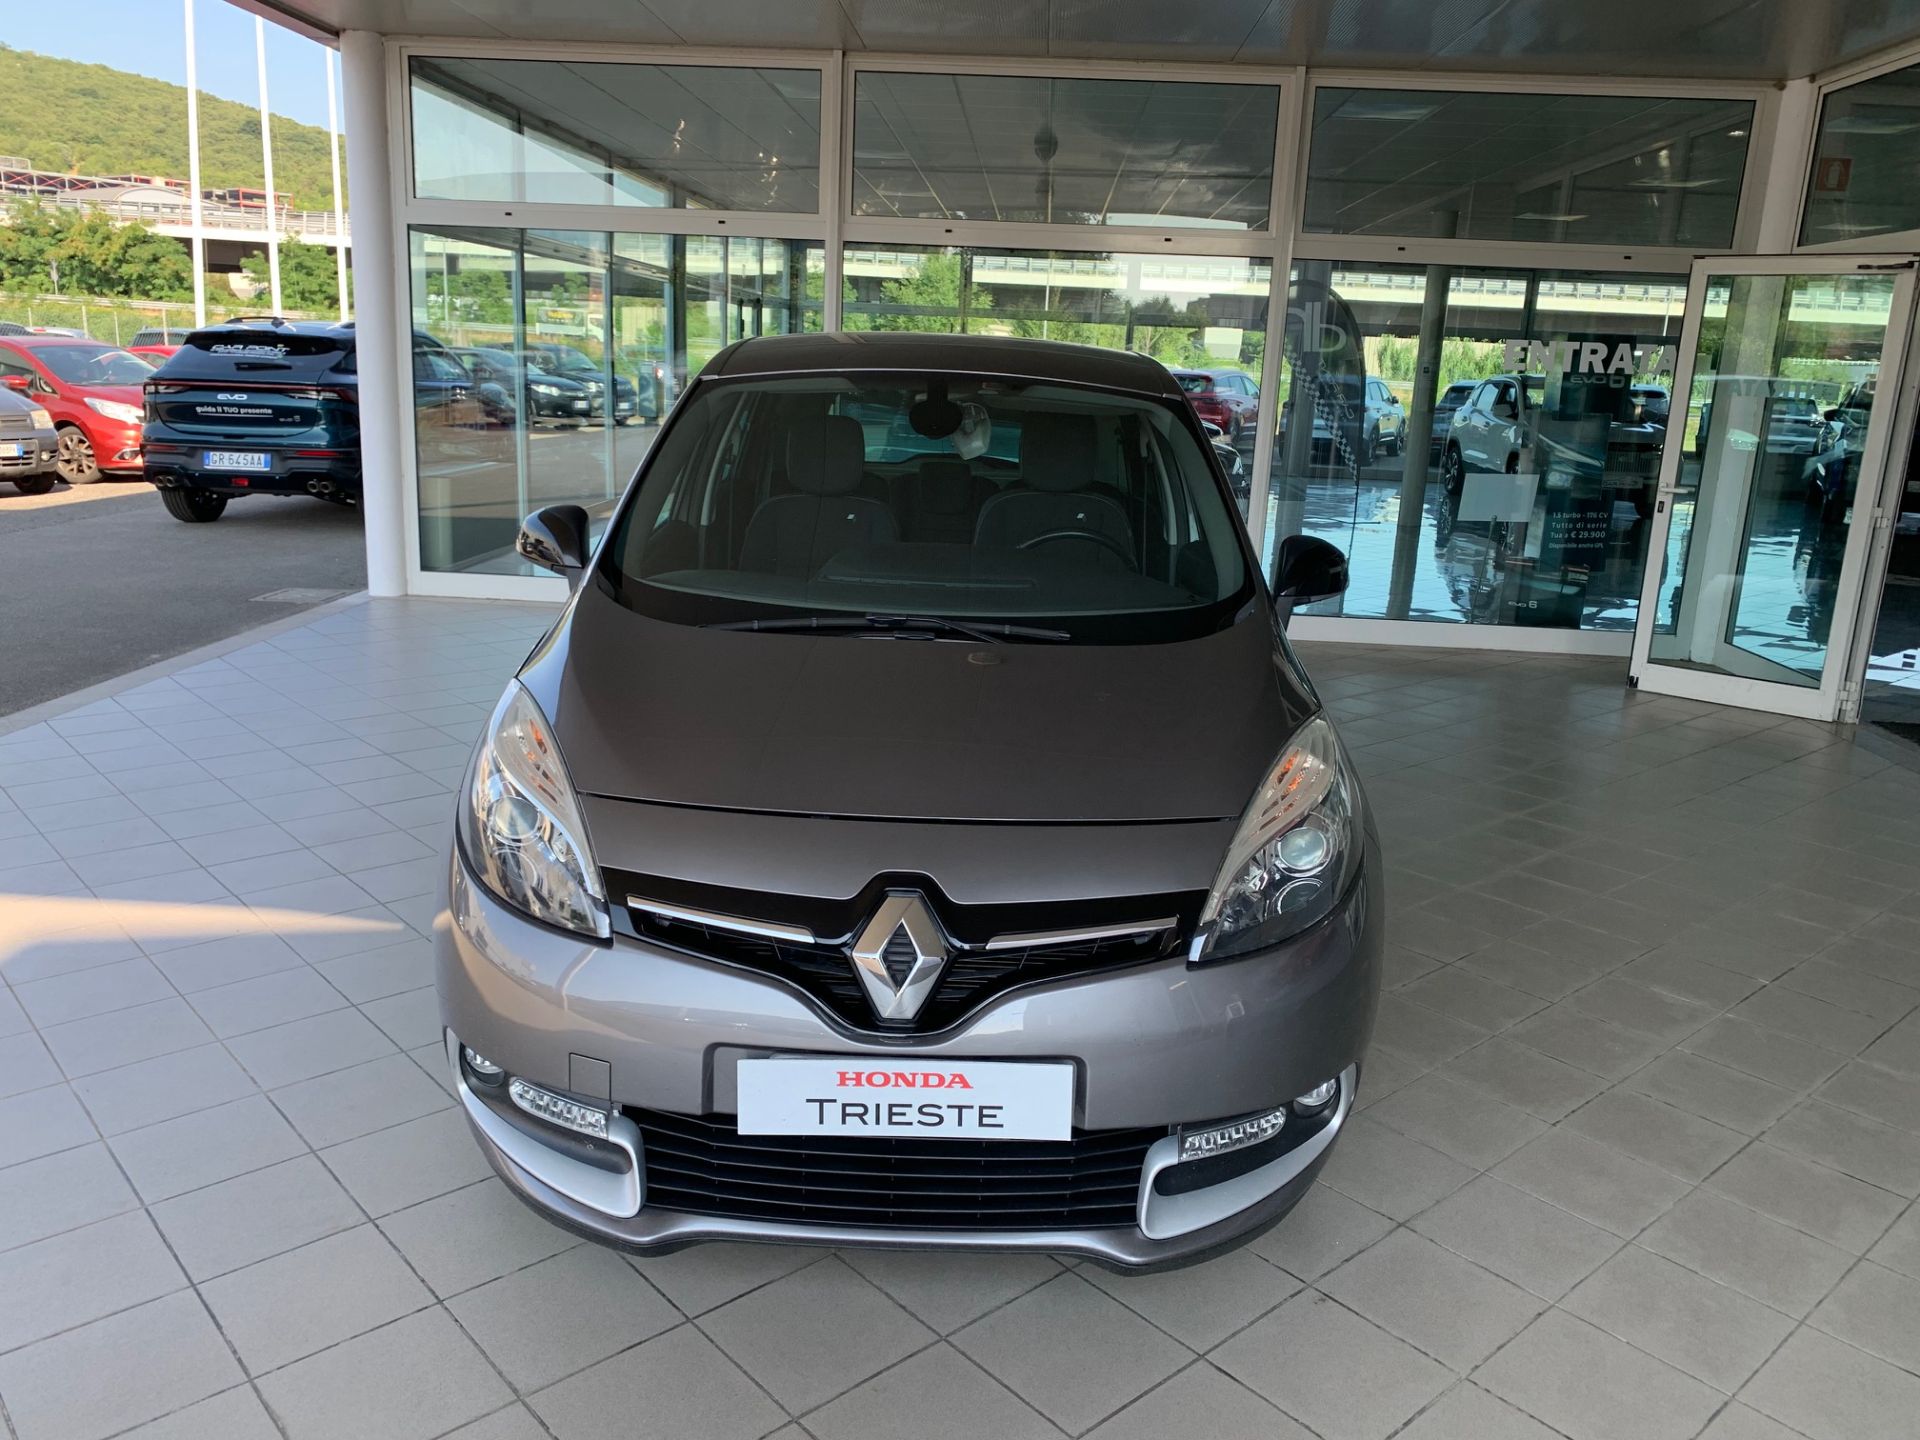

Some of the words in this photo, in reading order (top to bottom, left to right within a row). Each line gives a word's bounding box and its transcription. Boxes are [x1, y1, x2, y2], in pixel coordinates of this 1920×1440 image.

[1504, 339, 1677, 375] ENTRATA
[195, 405, 216, 413] guida
[836, 1070, 974, 1090] HONDA
[805, 1098, 1005, 1129] TRIESTE
